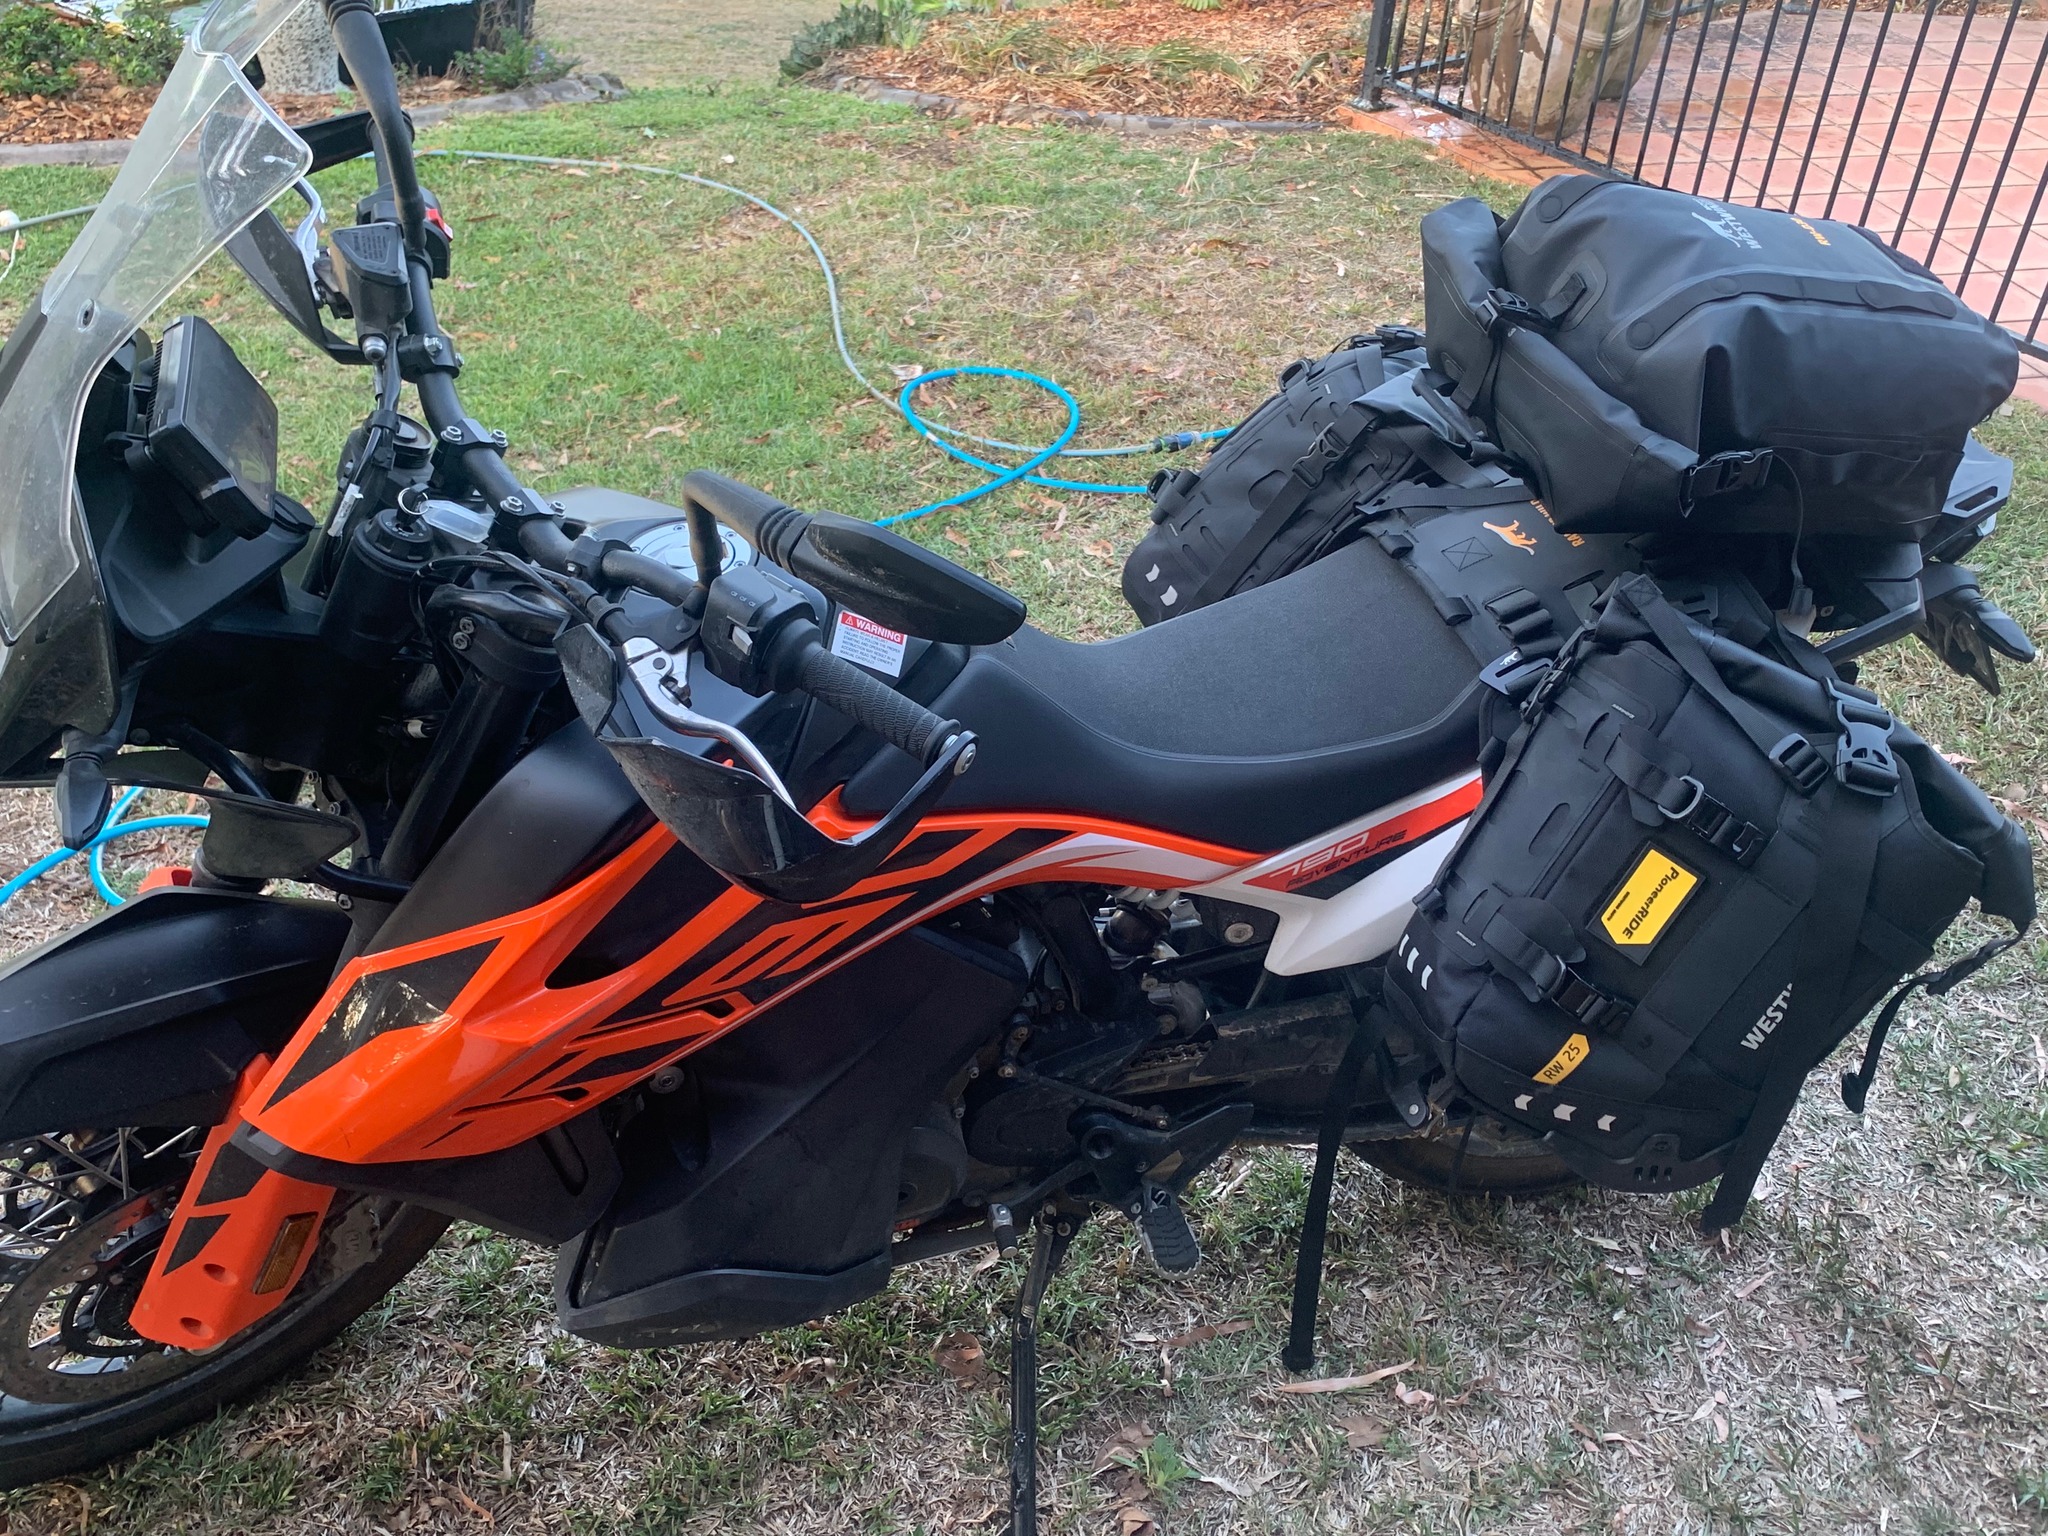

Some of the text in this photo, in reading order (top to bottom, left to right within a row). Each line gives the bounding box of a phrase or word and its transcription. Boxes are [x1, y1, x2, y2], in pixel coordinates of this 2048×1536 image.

[856, 618, 901, 642] WARNING
[1269, 832, 1370, 878] 790
[1286, 829, 1407, 888] ADVENTURE
[1543, 1043, 1581, 1080] RW 25
